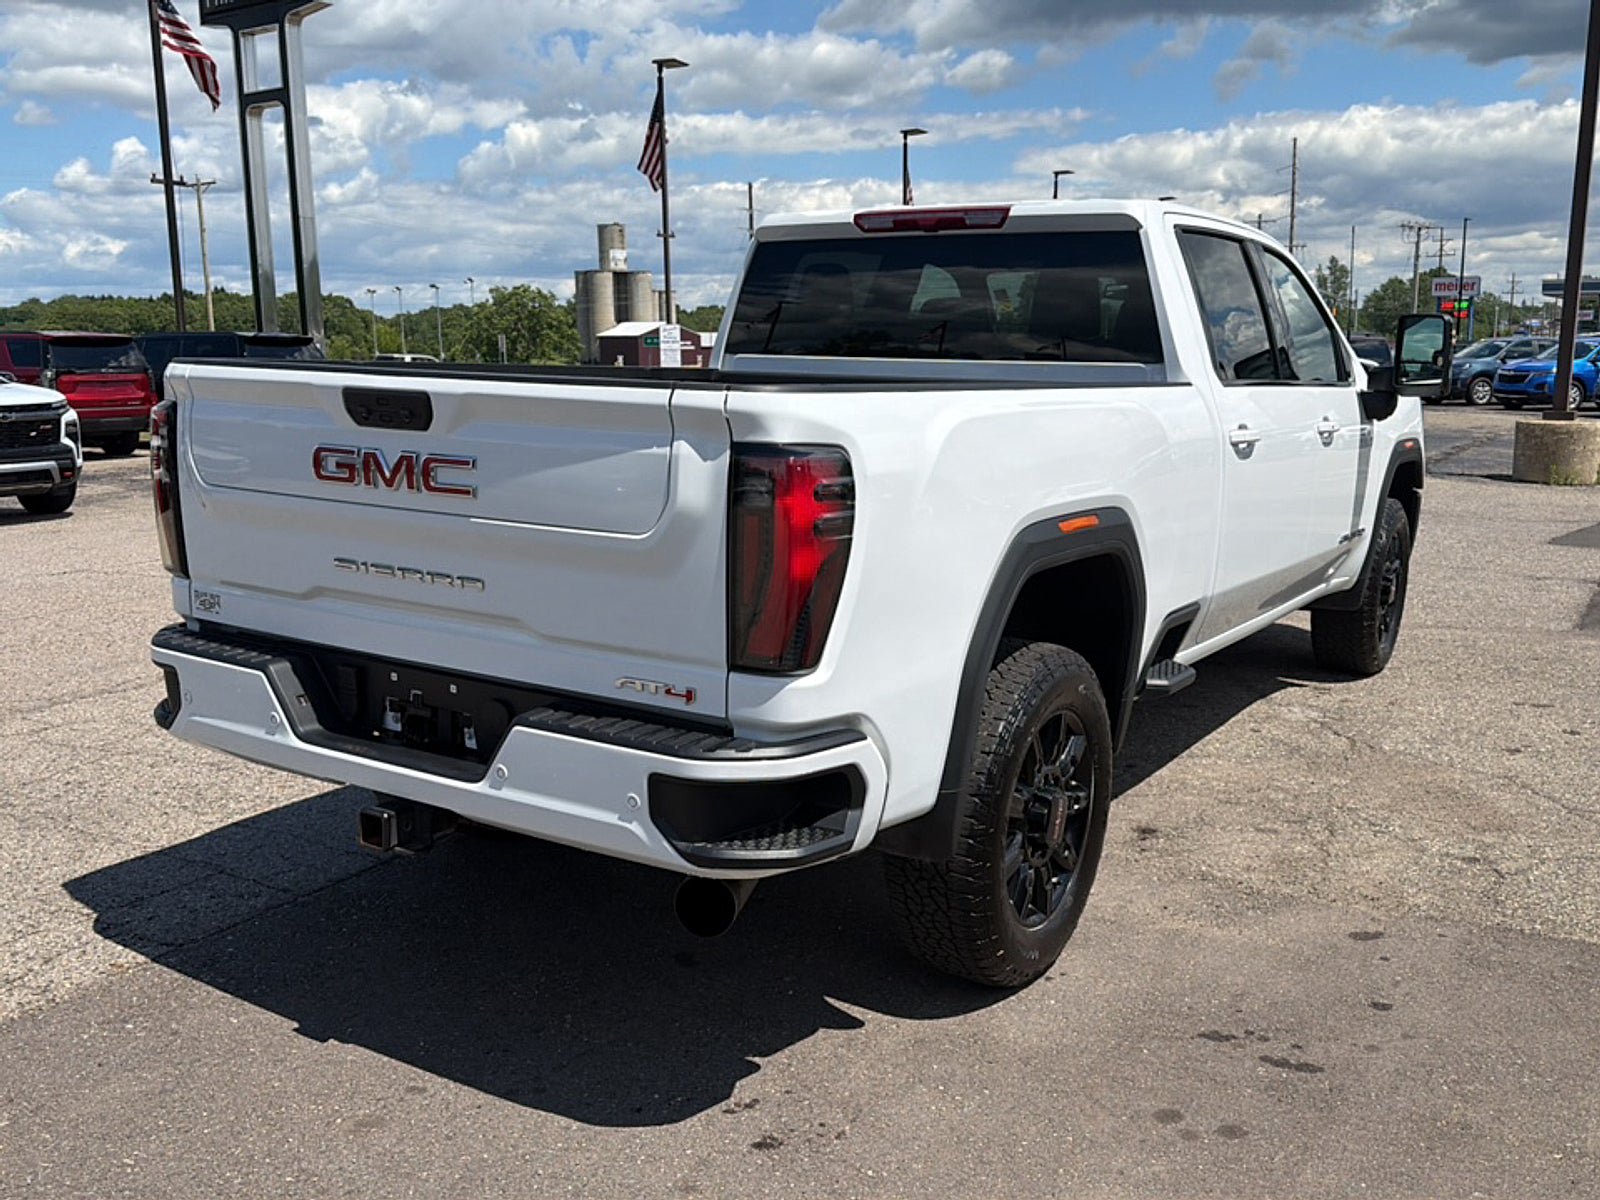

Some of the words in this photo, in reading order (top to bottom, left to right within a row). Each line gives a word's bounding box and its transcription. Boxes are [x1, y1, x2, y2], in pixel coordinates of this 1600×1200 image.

[1434, 279, 1477, 293] meier
[312, 443, 478, 499] GMC
[333, 557, 486, 592] SIERRA
[615, 676, 697, 705] AT4
